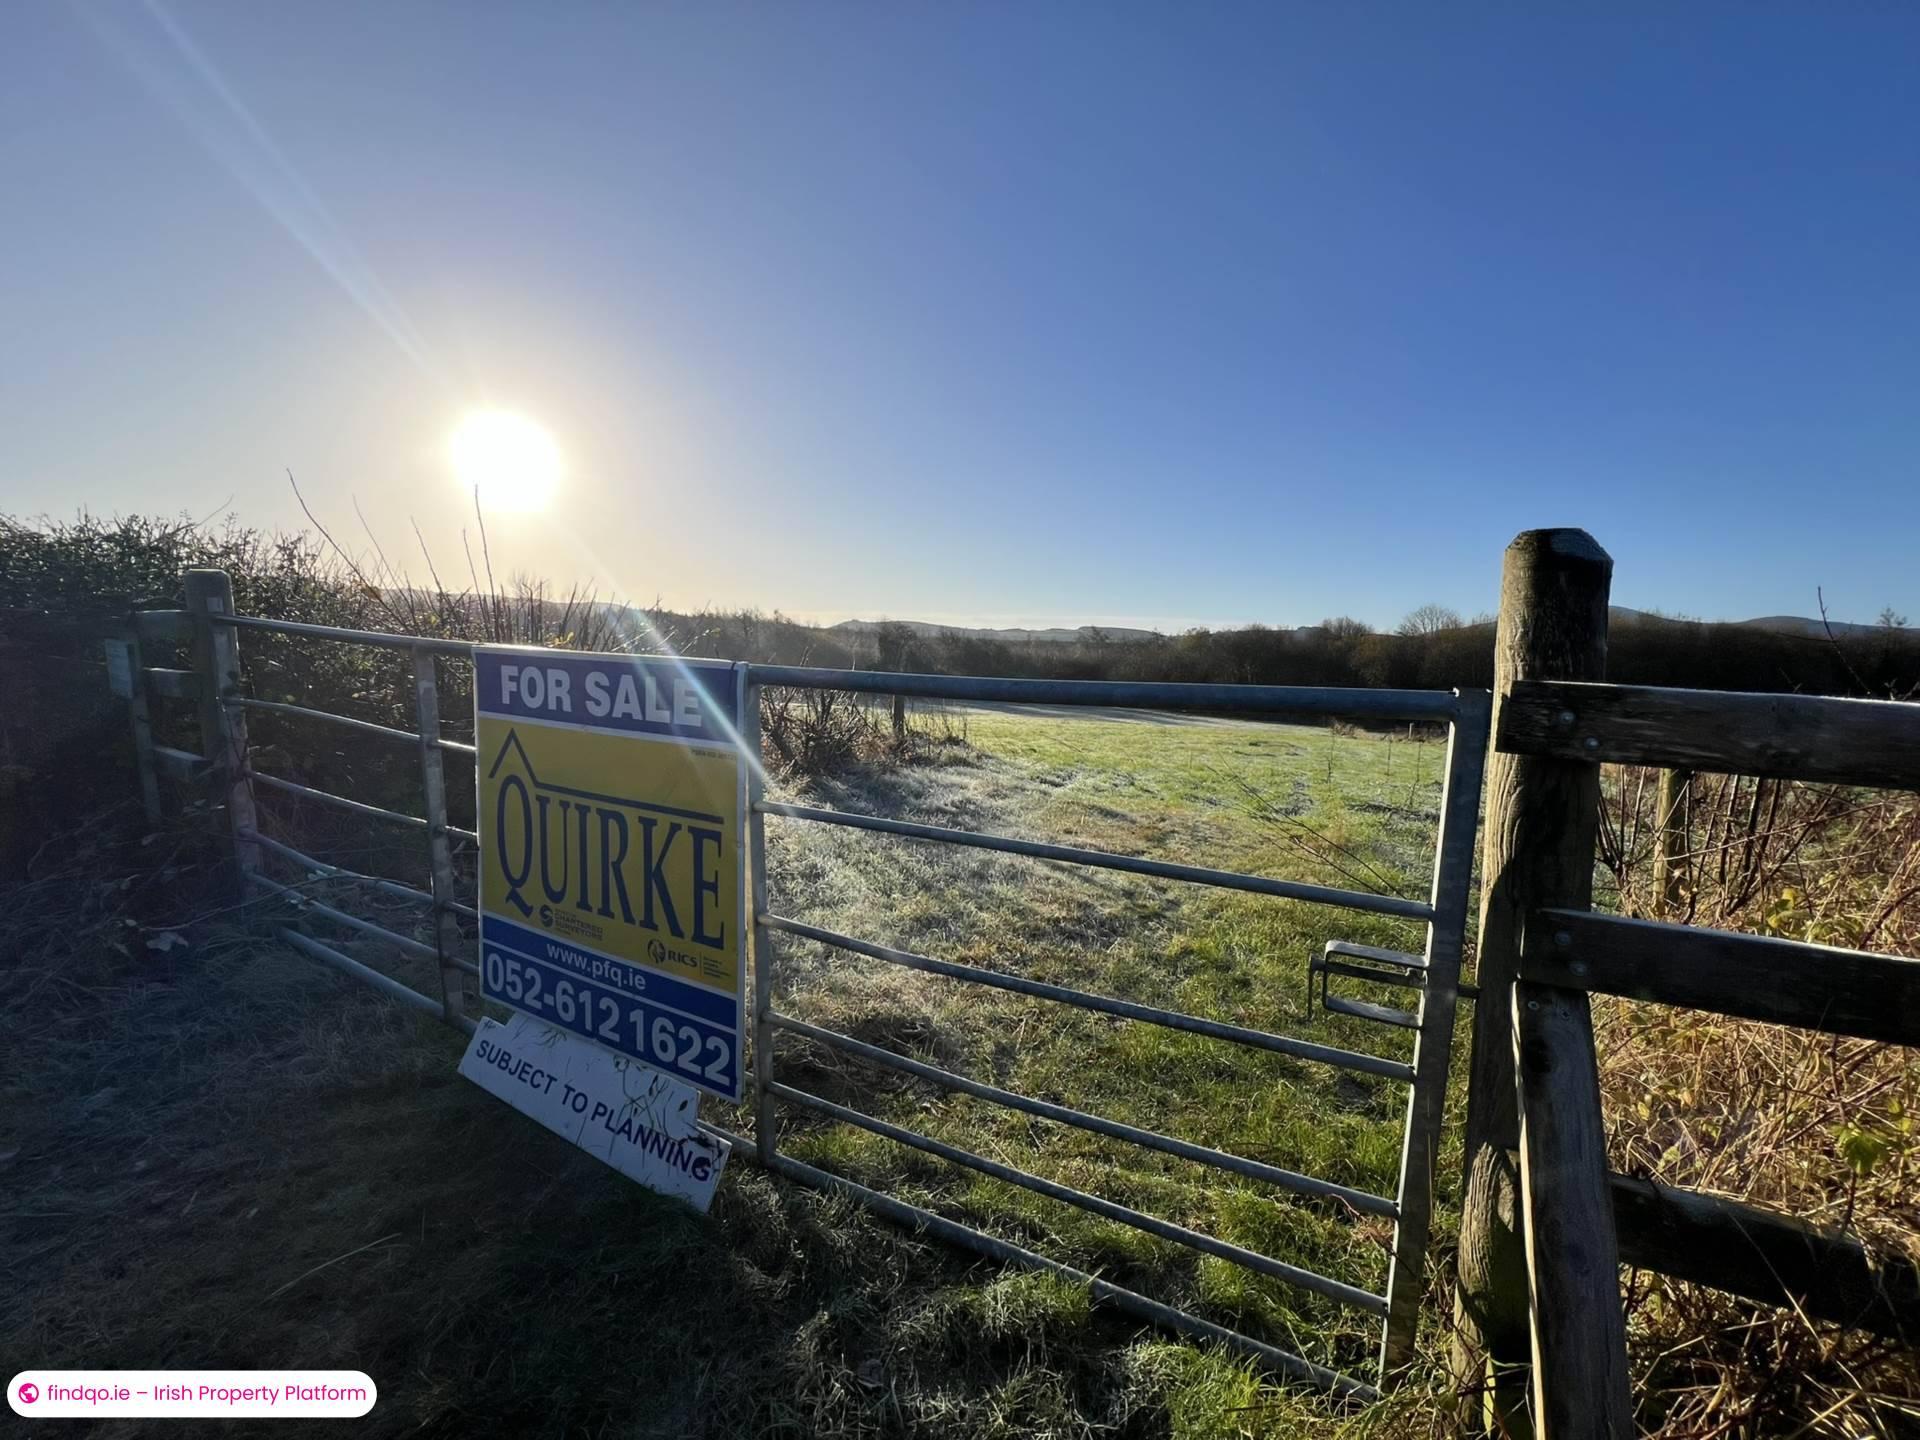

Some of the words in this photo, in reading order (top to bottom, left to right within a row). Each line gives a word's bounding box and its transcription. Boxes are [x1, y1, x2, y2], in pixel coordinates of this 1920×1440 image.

[501, 664, 572, 713] FOR
[585, 671, 702, 727] SALE
[498, 774, 724, 950] QUIRKE
[547, 943, 646, 990] www.pfq.ie
[667, 950, 698, 968] RICS
[475, 1039, 558, 1095] SUBJECT
[562, 1084, 589, 1114] TO
[591, 1102, 712, 1182] PLANNING
